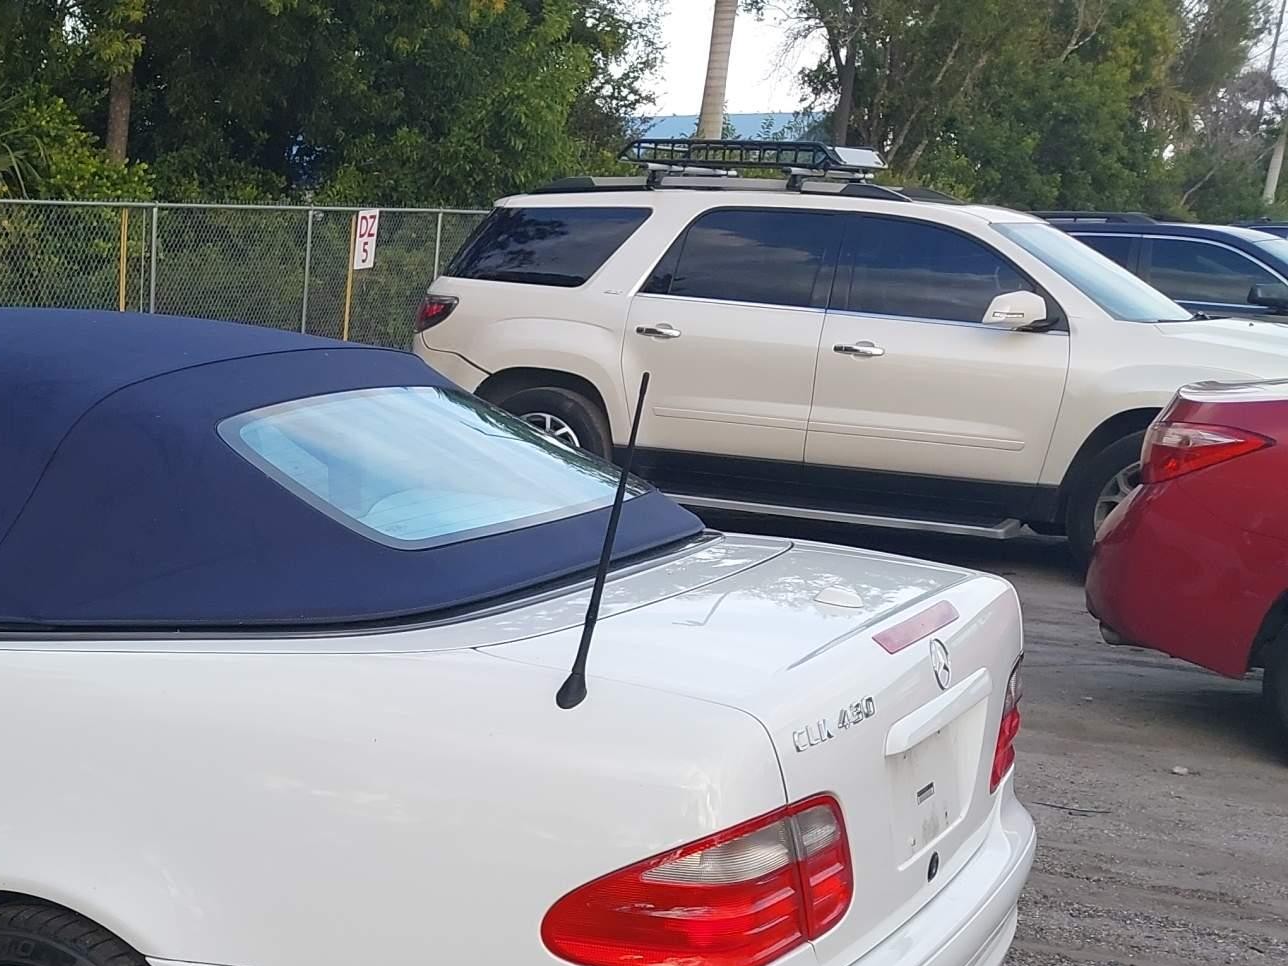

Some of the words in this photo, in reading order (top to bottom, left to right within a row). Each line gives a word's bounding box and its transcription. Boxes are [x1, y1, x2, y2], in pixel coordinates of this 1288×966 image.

[359, 214, 377, 238] DZ
[361, 241, 369, 263] 5
[793, 719, 834, 753] CLK
[838, 696, 876, 730] 430
